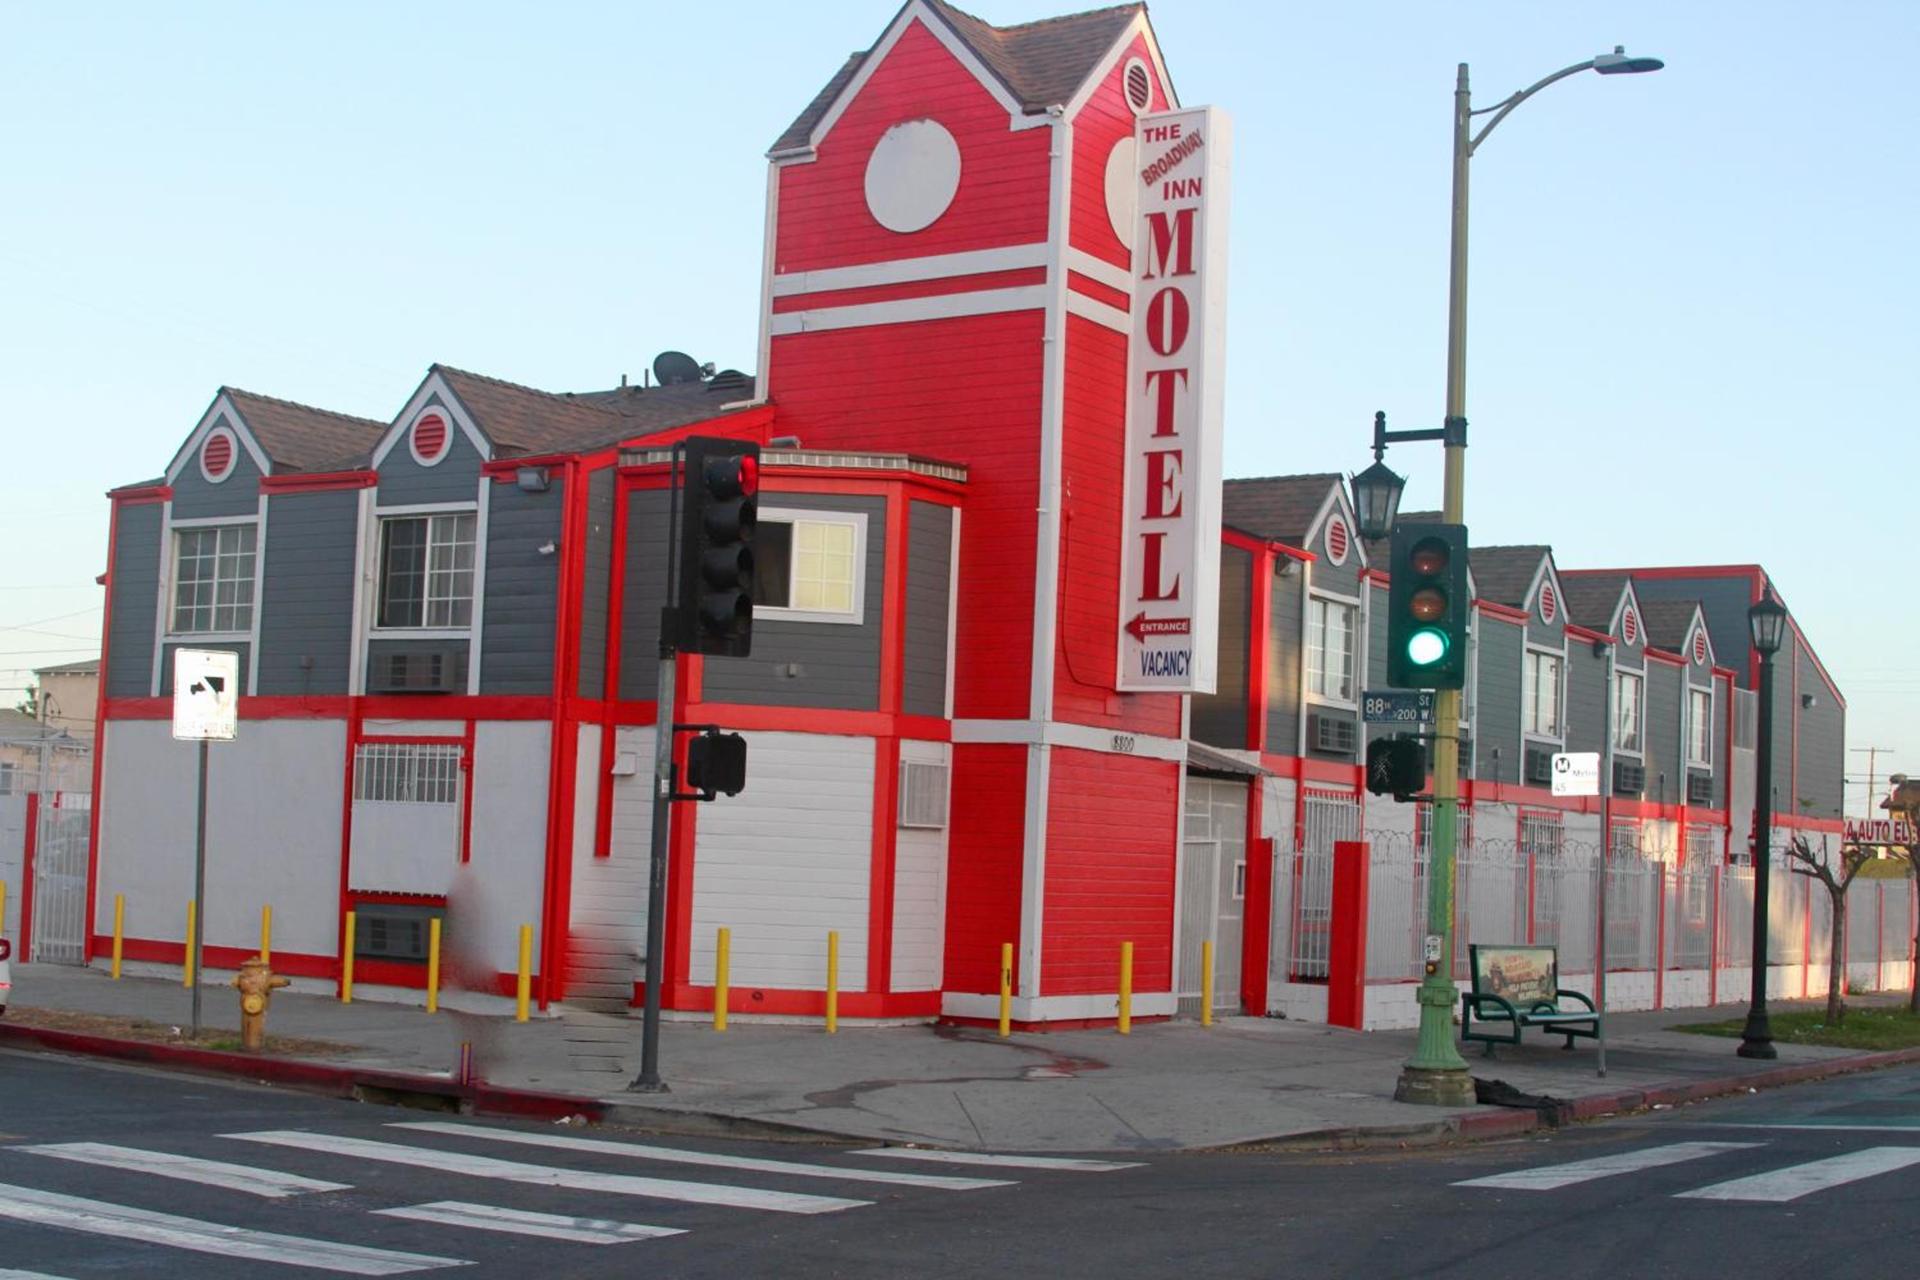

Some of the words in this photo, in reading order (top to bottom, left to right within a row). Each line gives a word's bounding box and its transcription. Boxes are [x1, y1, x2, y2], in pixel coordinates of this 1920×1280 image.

[1143, 123, 1181, 143] THE
[1141, 128, 1205, 187] BROADWAY
[1163, 177, 1203, 201] INN
[1138, 207, 1199, 602] MOTEL
[1139, 621, 1188, 633] ENTRANCE
[1140, 650, 1193, 677] VACANCY
[1858, 820, 1890, 842] AUTO
